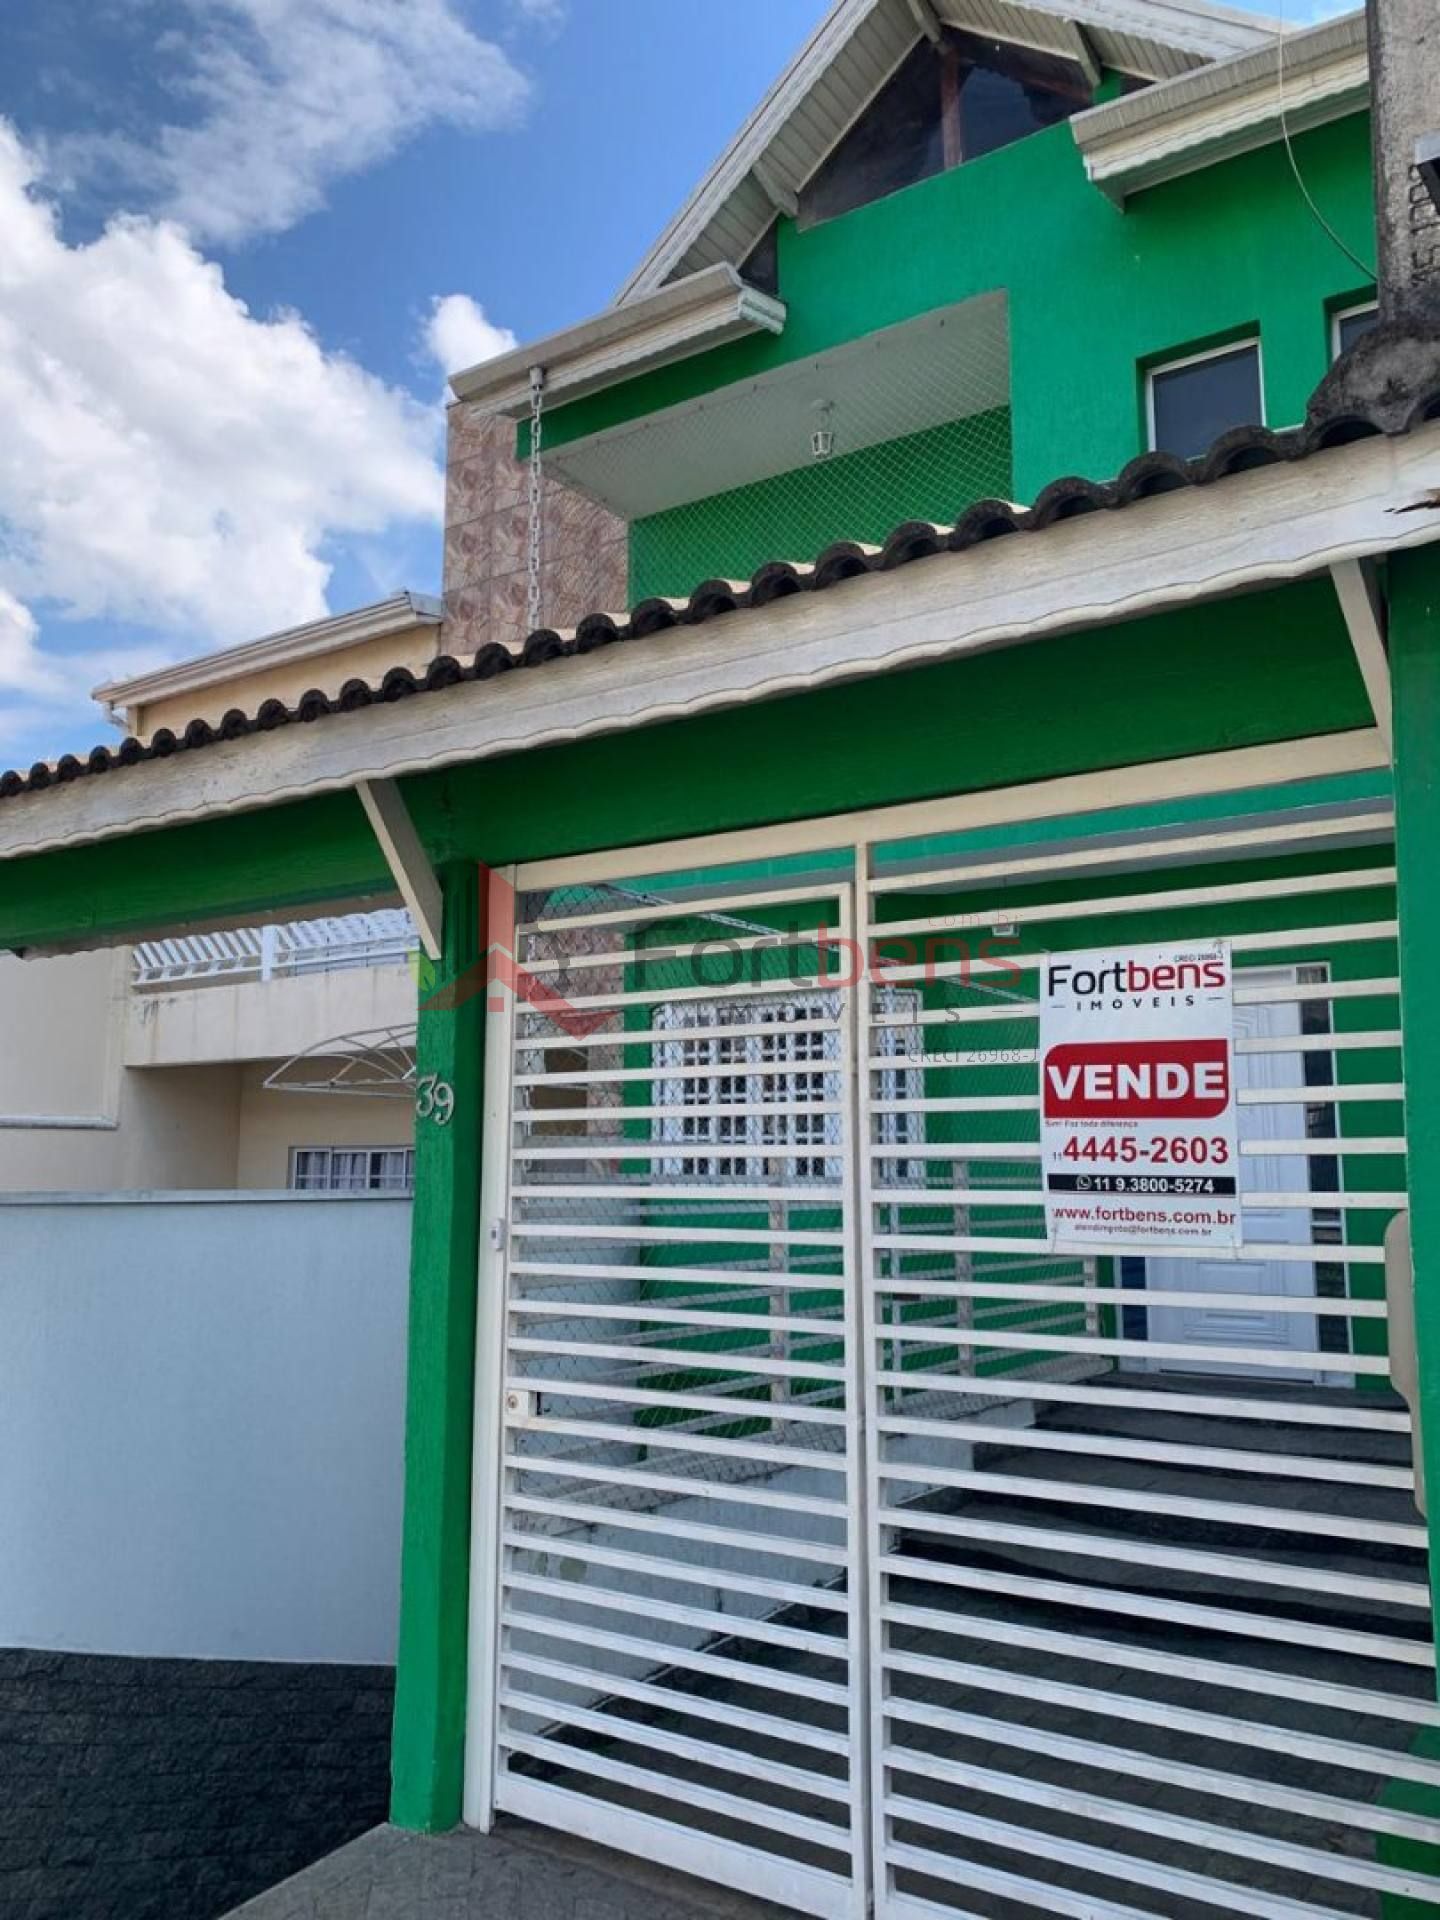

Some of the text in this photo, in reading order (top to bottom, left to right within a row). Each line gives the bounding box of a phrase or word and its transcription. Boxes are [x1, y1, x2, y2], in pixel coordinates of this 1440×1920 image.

[1048, 959, 1226, 997] Fortbens
[1047, 1062, 1226, 1100] VENDE
[416, 1072, 454, 1126] 39
[1062, 1136, 1229, 1164] 4445-2603
[1094, 1177, 1214, 1194] 11 9.3800-5274
[1054, 1205, 1236, 1225] www.fortbens.com.br
